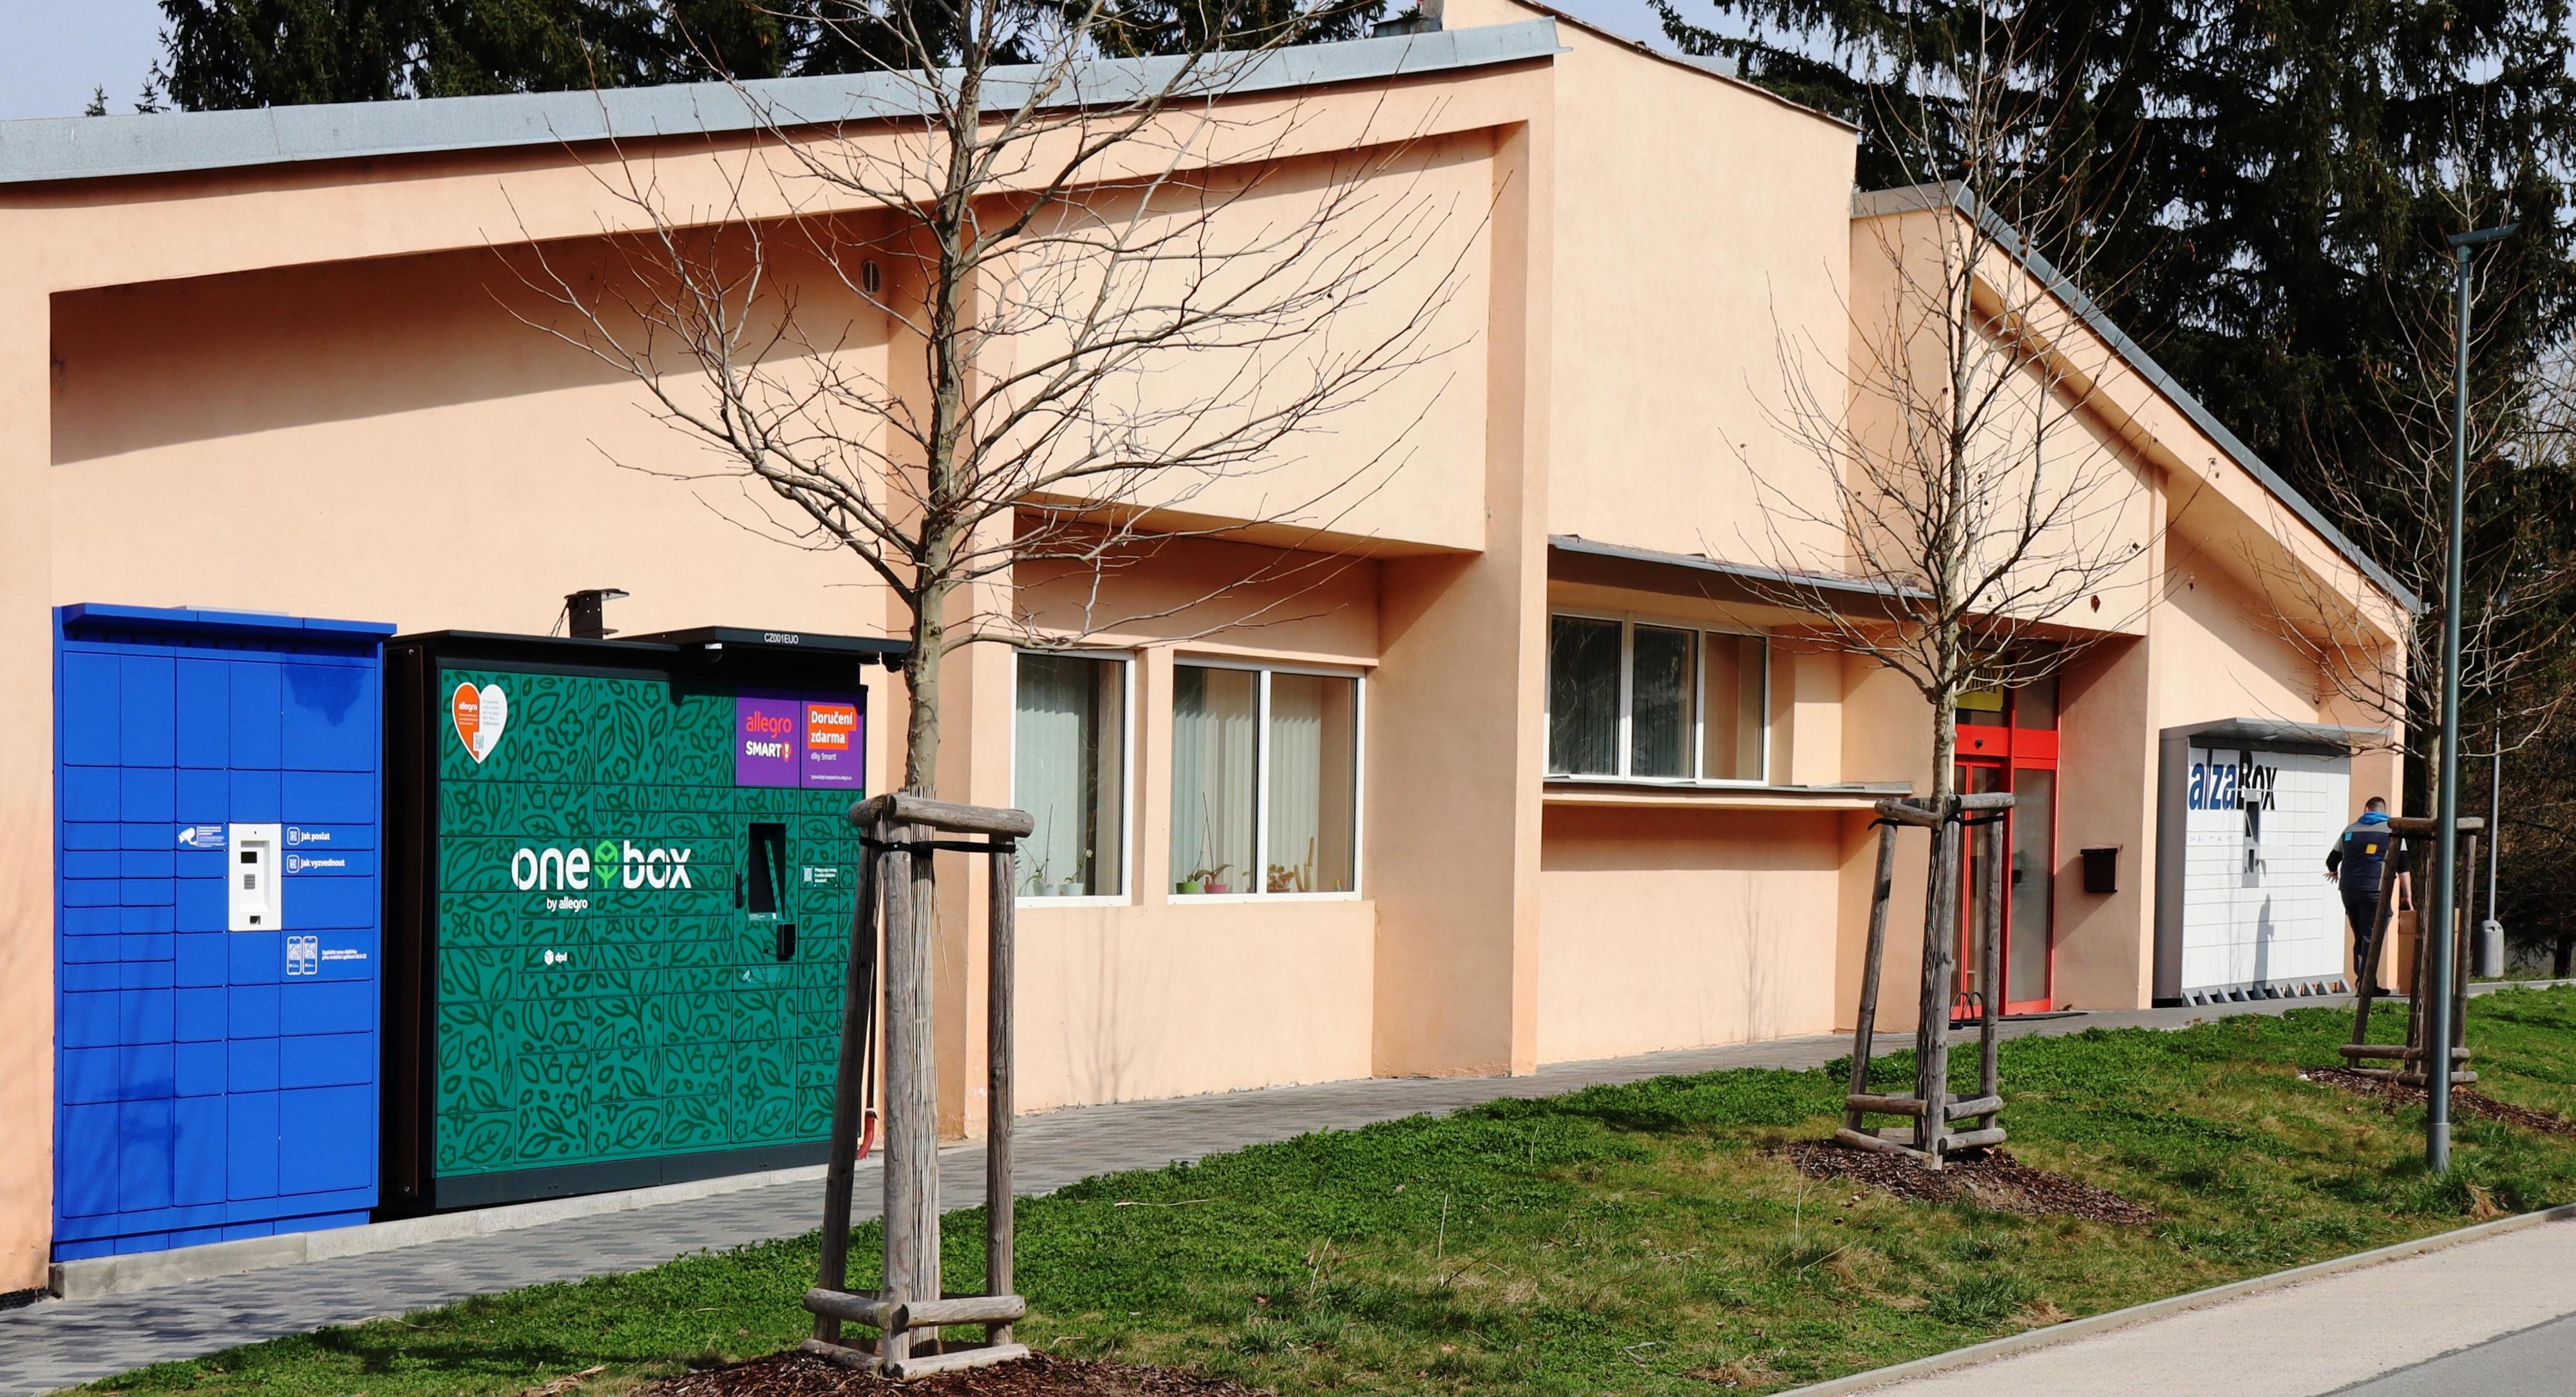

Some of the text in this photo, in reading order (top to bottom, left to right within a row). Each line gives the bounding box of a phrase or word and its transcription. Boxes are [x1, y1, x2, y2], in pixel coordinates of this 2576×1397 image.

[458, 701, 478, 713] allegro
[811, 710, 853, 725] Doručení
[746, 711, 792, 739] allegro
[811, 730, 846, 744] zdarma
[300, 832, 331, 842] Jak poslat
[300, 858, 346, 870] Jak vyzvednout
[511, 840, 692, 891] one box
[546, 896, 588, 913] by allegro
[555, 951, 567, 962] dpd
